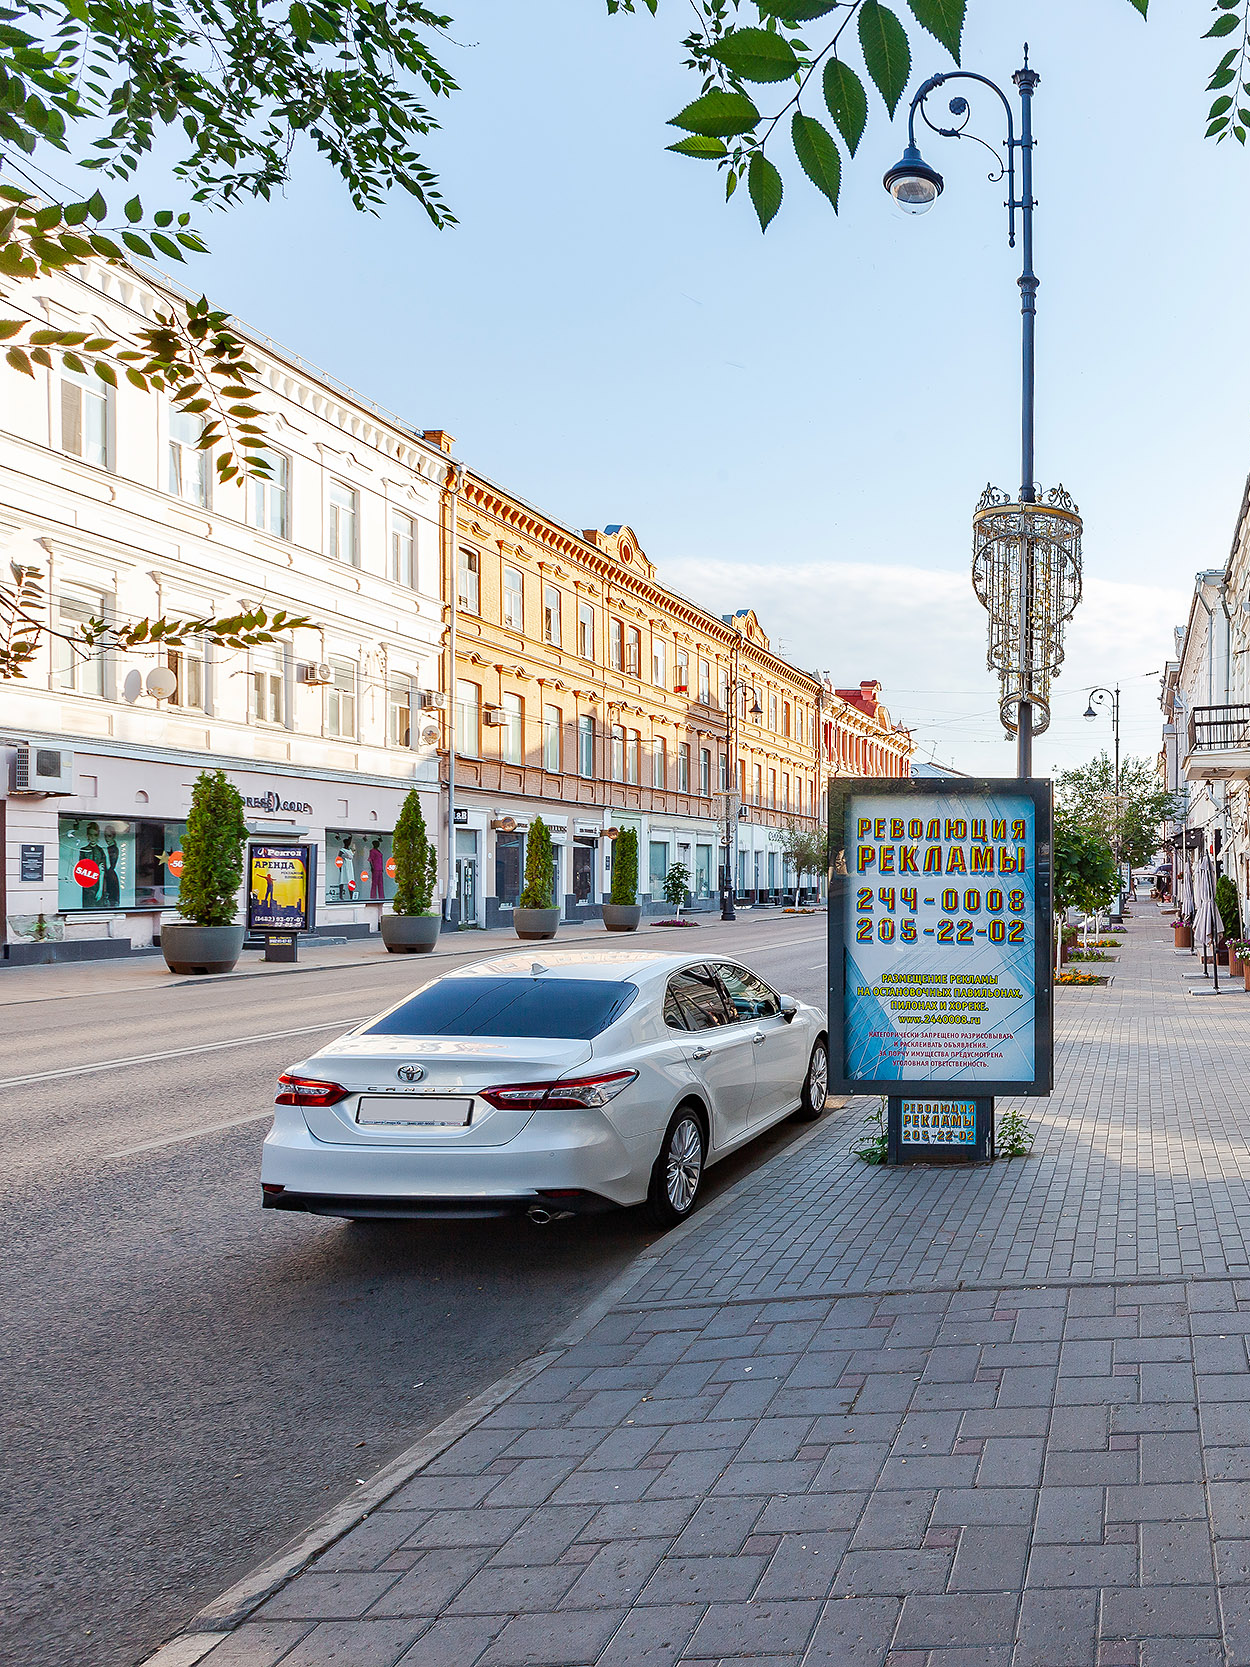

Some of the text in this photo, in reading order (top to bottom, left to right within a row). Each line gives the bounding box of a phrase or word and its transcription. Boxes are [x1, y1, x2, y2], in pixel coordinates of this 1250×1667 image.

[282, 800, 309, 813] CODE
[857, 817, 1026, 843] РЕВОЛЮЦИЯ
[170, 860, 186, 868] -50
[254, 861, 295, 870] АРЕНДА
[857, 845, 1026, 876] РЕКЛАМЫ
[75, 866, 99, 881] SALE
[856, 887, 1026, 914] 244-0008
[856, 917, 1026, 945] 205-22-02
[882, 973, 998, 985] РАЗМЕЩЕНИЕ РЕКЛАМЫ
[857, 986, 1023, 999] НА ОСТАНОВОЧНЫХ ПАВИЛЬОНАХ,
[890, 1000, 989, 1011] ПИЛОНАХ И ХОРЕКЕ.
[898, 1014, 981, 1024] www.2440008.ru
[868, 1031, 919, 1039] КАТЕГОРИЧЕСКИ
[950, 1051, 1004, 1059] ПРЕДУСМОТРЕНА
[903, 1103, 975, 1115] РЕВОЛЮЦИЯ
[903, 1114, 975, 1129] РЕКЛАМЫ
